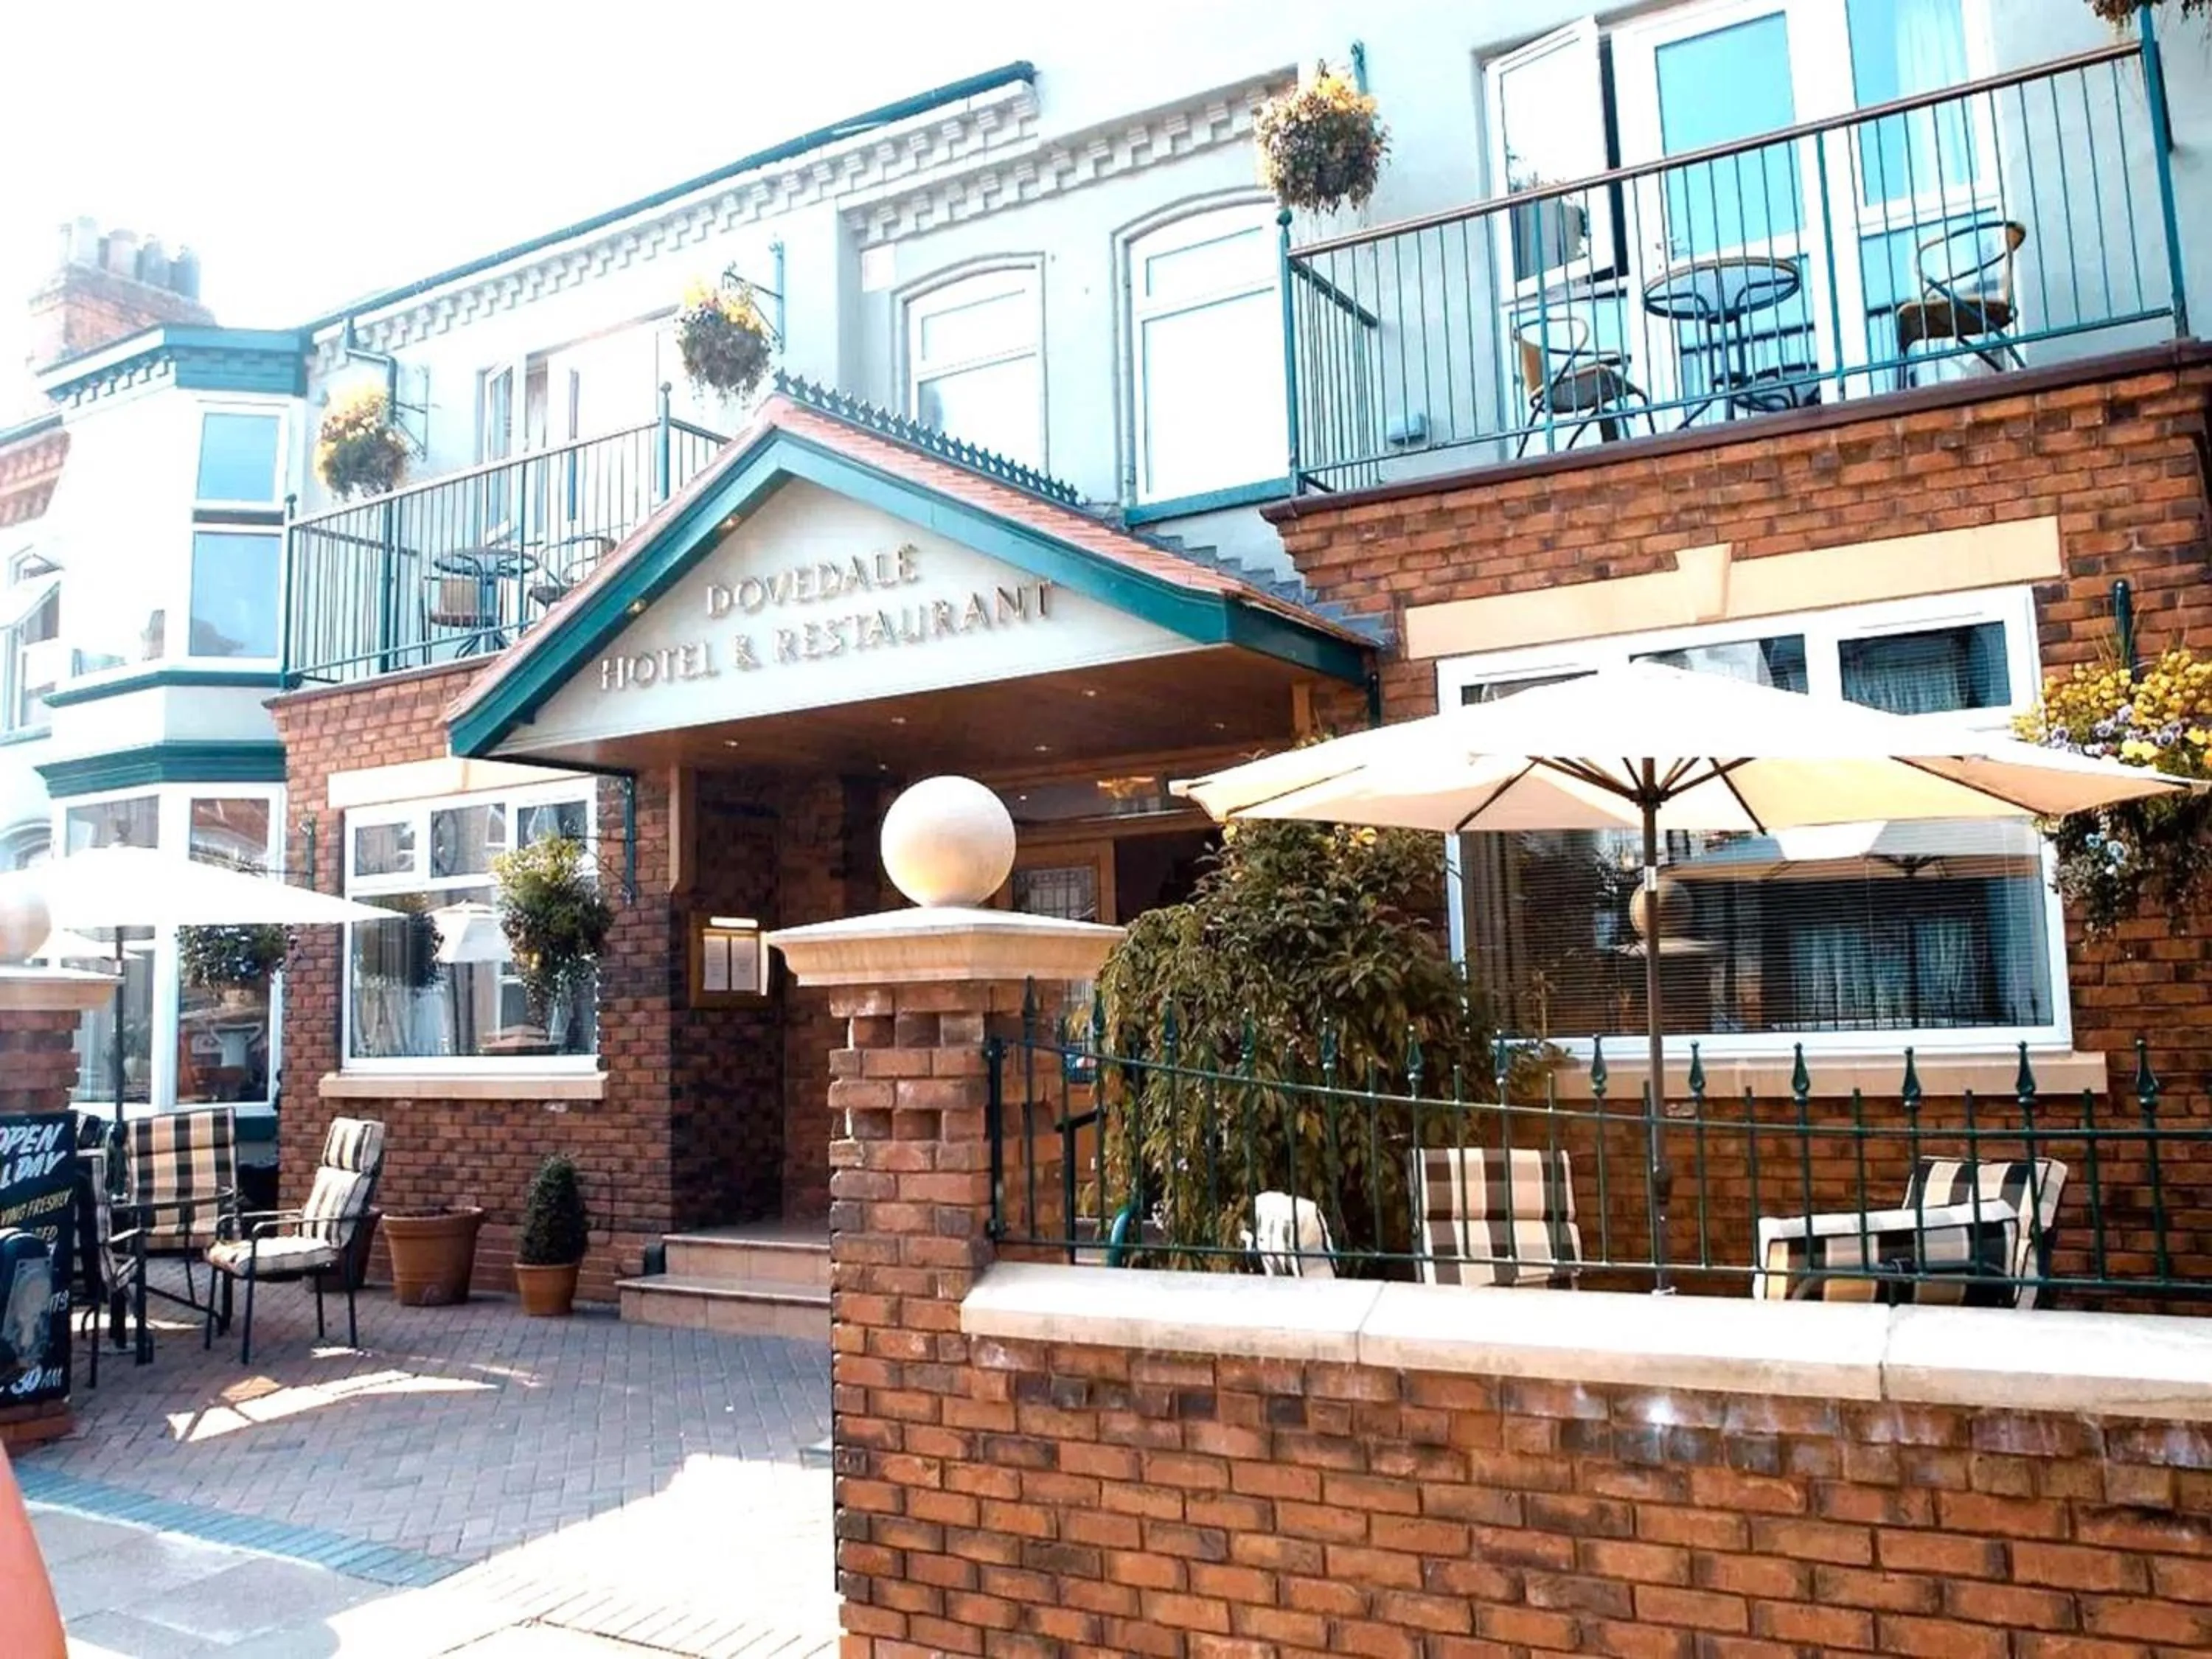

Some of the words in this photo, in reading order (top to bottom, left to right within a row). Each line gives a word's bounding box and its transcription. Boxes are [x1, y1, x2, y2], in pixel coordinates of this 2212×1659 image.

[706, 542, 921, 620] DOVEDALE
[599, 639, 720, 692] HOTEL
[734, 633, 762, 672] &
[774, 578, 1054, 665] RESTAURANT
[13, 1150, 67, 1183] DAY
